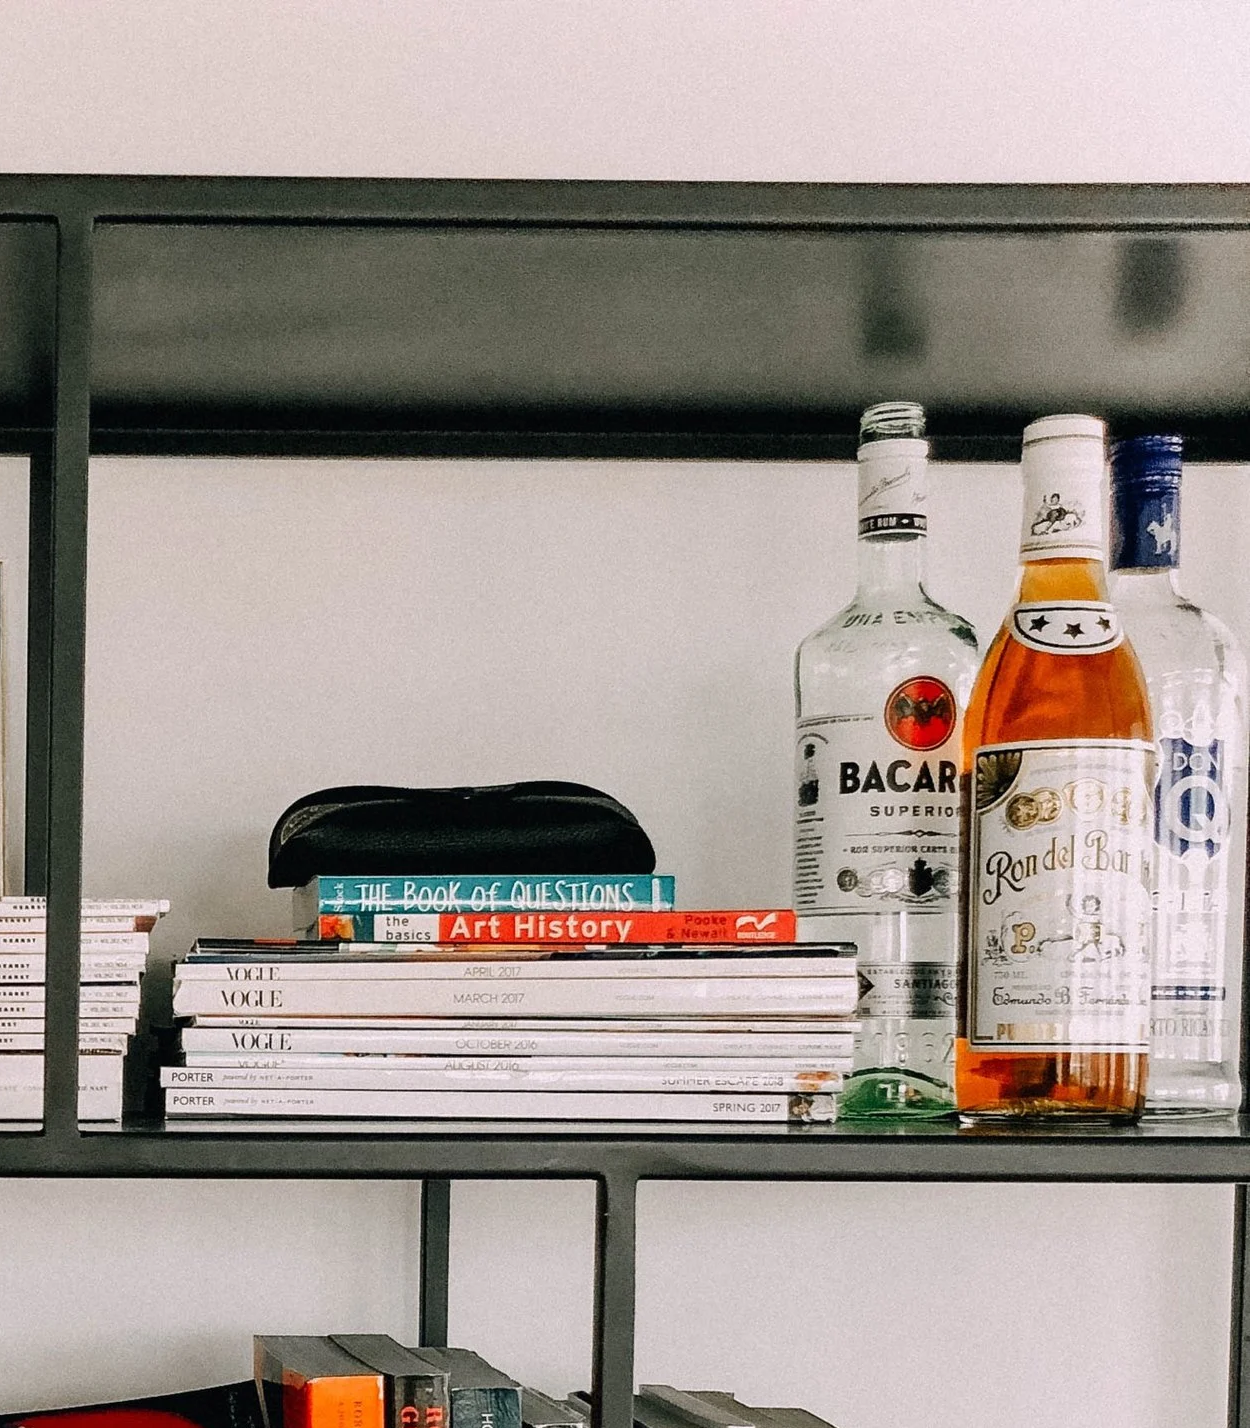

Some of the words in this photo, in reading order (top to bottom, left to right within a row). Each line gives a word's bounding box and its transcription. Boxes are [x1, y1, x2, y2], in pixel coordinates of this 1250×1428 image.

[838, 760, 958, 794] BACAR
[870, 805, 963, 818] SUPERIO
[982, 850, 1038, 905] Ron
[1042, 834, 1075, 872] del
[355, 883, 393, 912] THE
[404, 881, 462, 913] BOOK
[510, 879, 636, 912] QUESTIONS
[385, 916, 410, 927] the
[449, 915, 501, 939] Art
[514, 914, 634, 943] History
[385, 930, 432, 942] basics
[220, 989, 283, 1008] VOGUE
[452, 993, 498, 1005] MARCH
[501, 993, 525, 1004] 2017
[231, 1032, 292, 1051] VOGUE
[455, 1038, 512, 1050] OCTOBER
[514, 1038, 538, 1050] 2016
[172, 1096, 215, 1107] PORTER
[712, 1100, 757, 1112] SPRING
[759, 1101, 782, 1112] 2017
